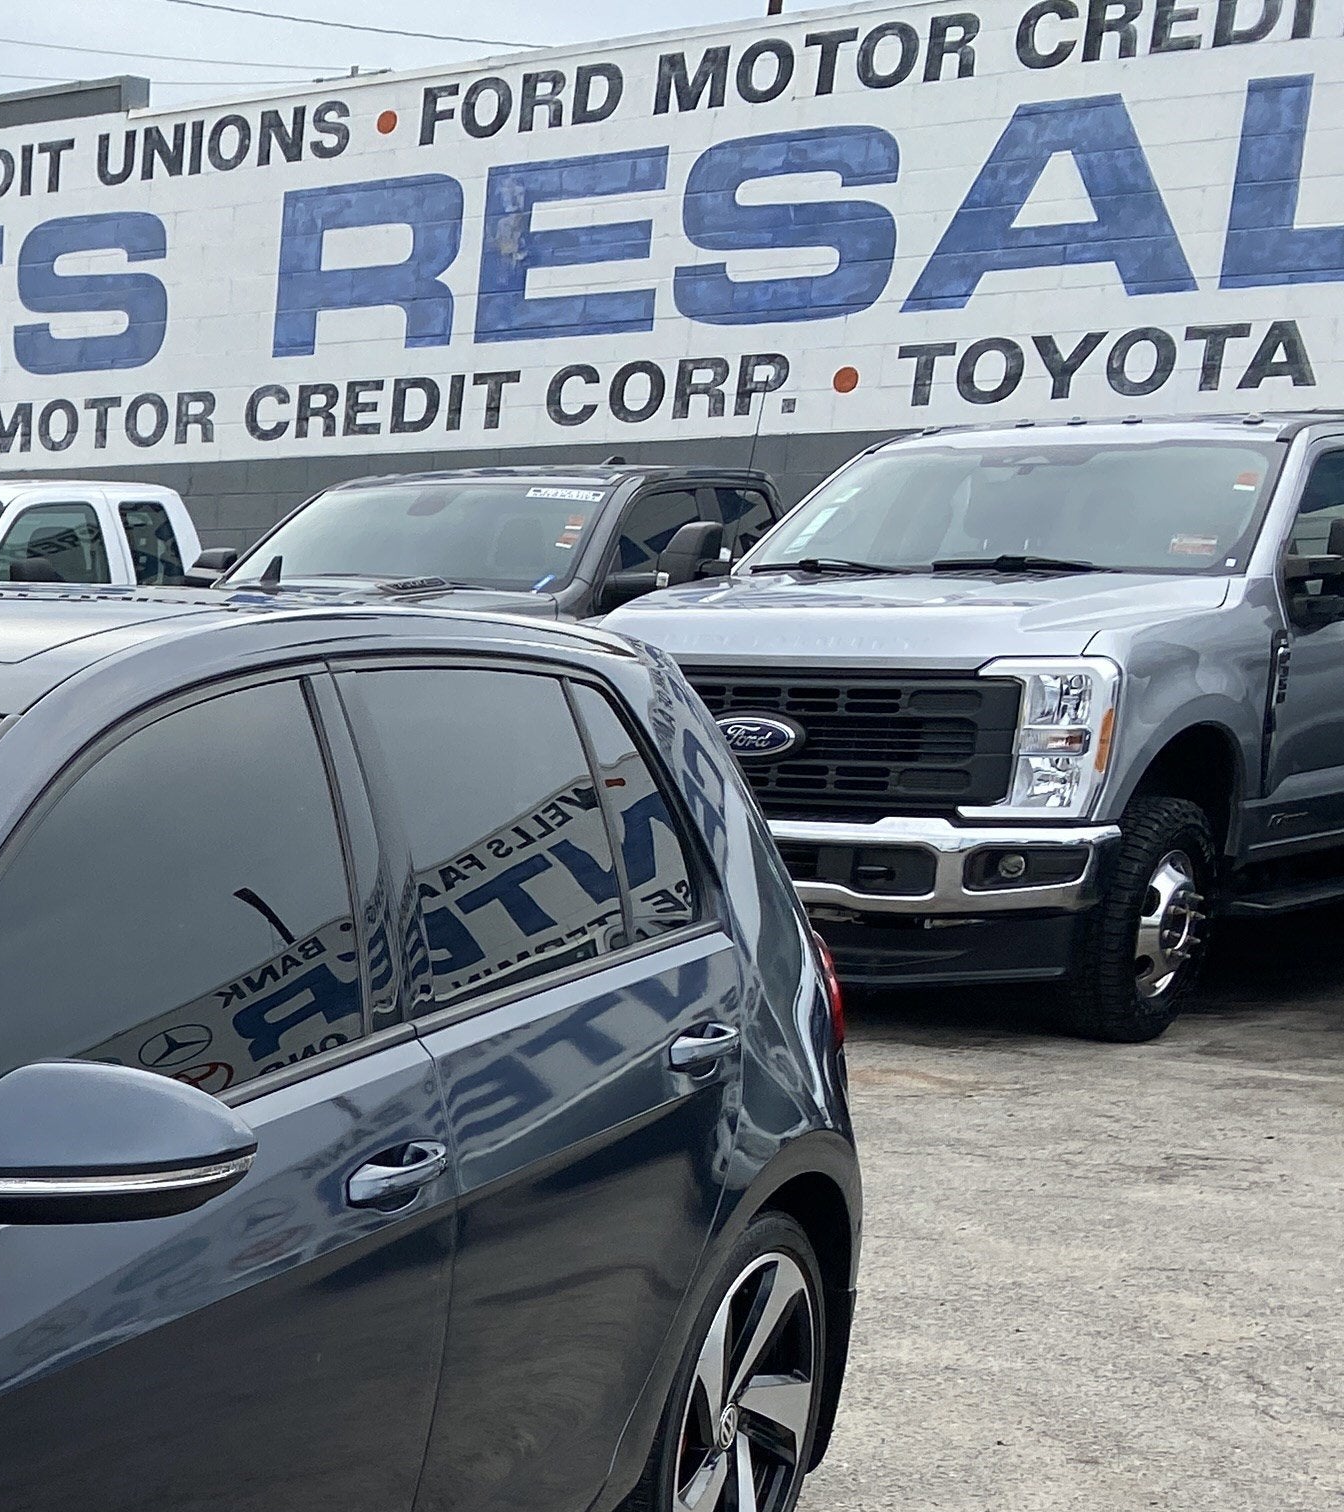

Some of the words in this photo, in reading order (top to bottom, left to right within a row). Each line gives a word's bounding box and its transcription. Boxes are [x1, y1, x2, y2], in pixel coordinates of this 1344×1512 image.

[96, 100, 352, 187] UNIONS
[418, 62, 624, 147] FORD
[653, 12, 981, 117] MOTOR
[1015, 0, 1344, 70] CREDI
[271, 73, 1344, 358] RESAL
[244, 370, 522, 441] CREDIT
[545, 353, 798, 427] CORP.
[898, 319, 1318, 407] TOYOTA
[725, 724, 773, 748] Ford
